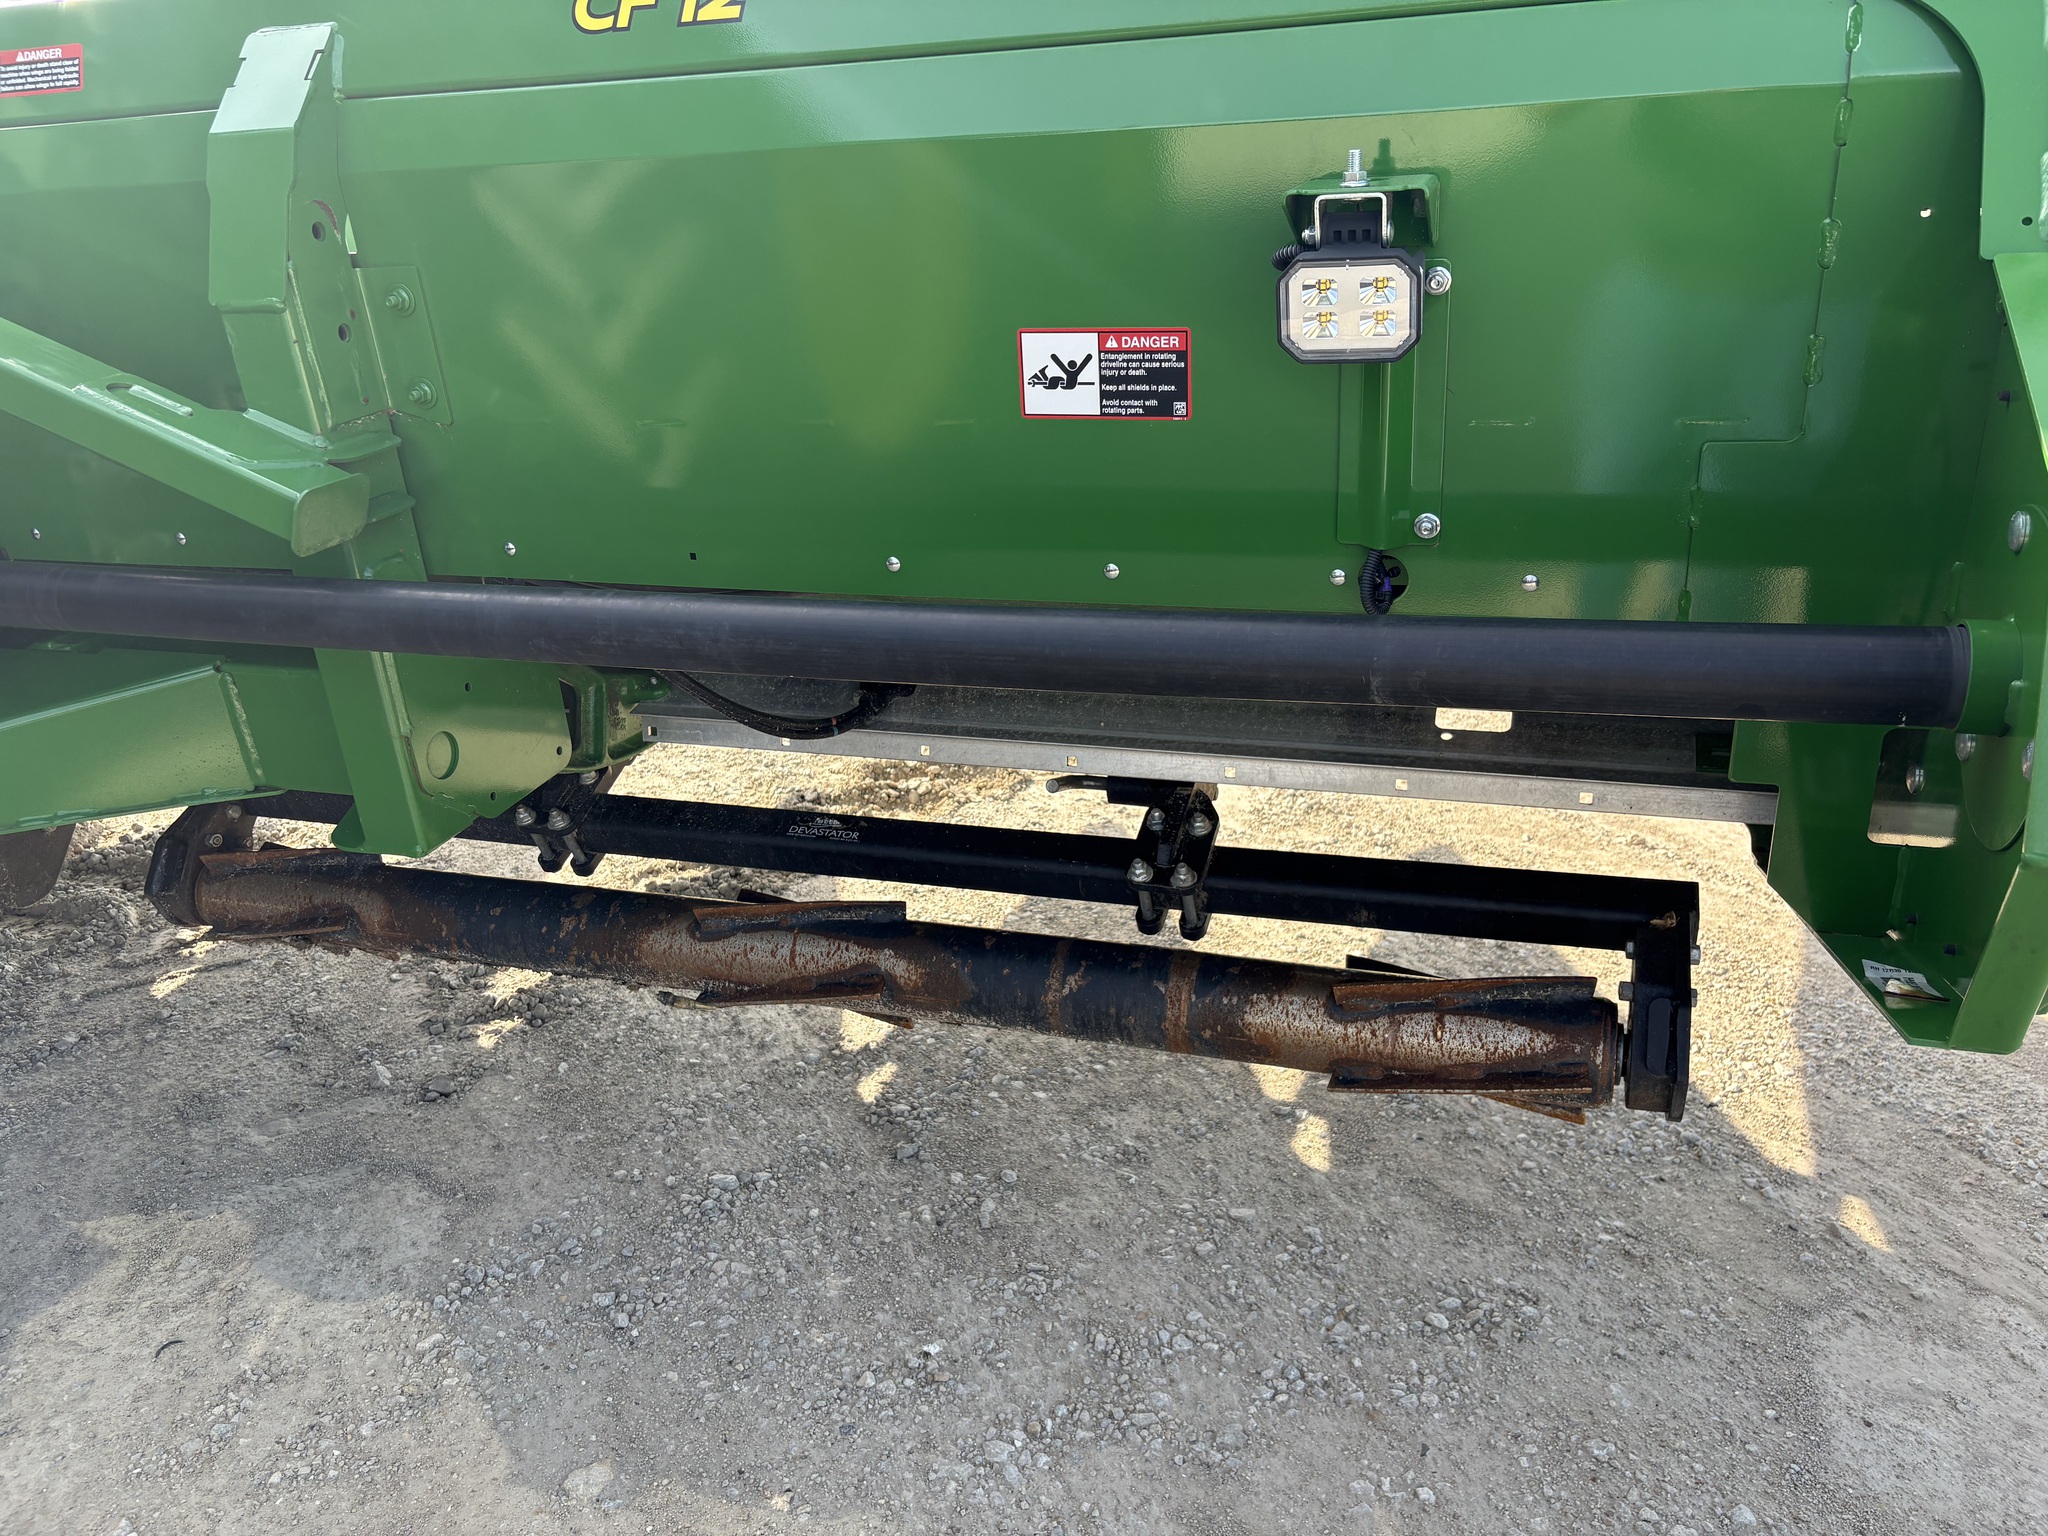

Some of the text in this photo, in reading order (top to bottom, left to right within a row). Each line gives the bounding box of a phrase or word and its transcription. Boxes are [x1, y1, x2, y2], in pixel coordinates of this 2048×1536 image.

[24, 48, 62, 61] DANGER
[1121, 336, 1179, 348] DANGER
[789, 826, 860, 839] DEVASTATOR
